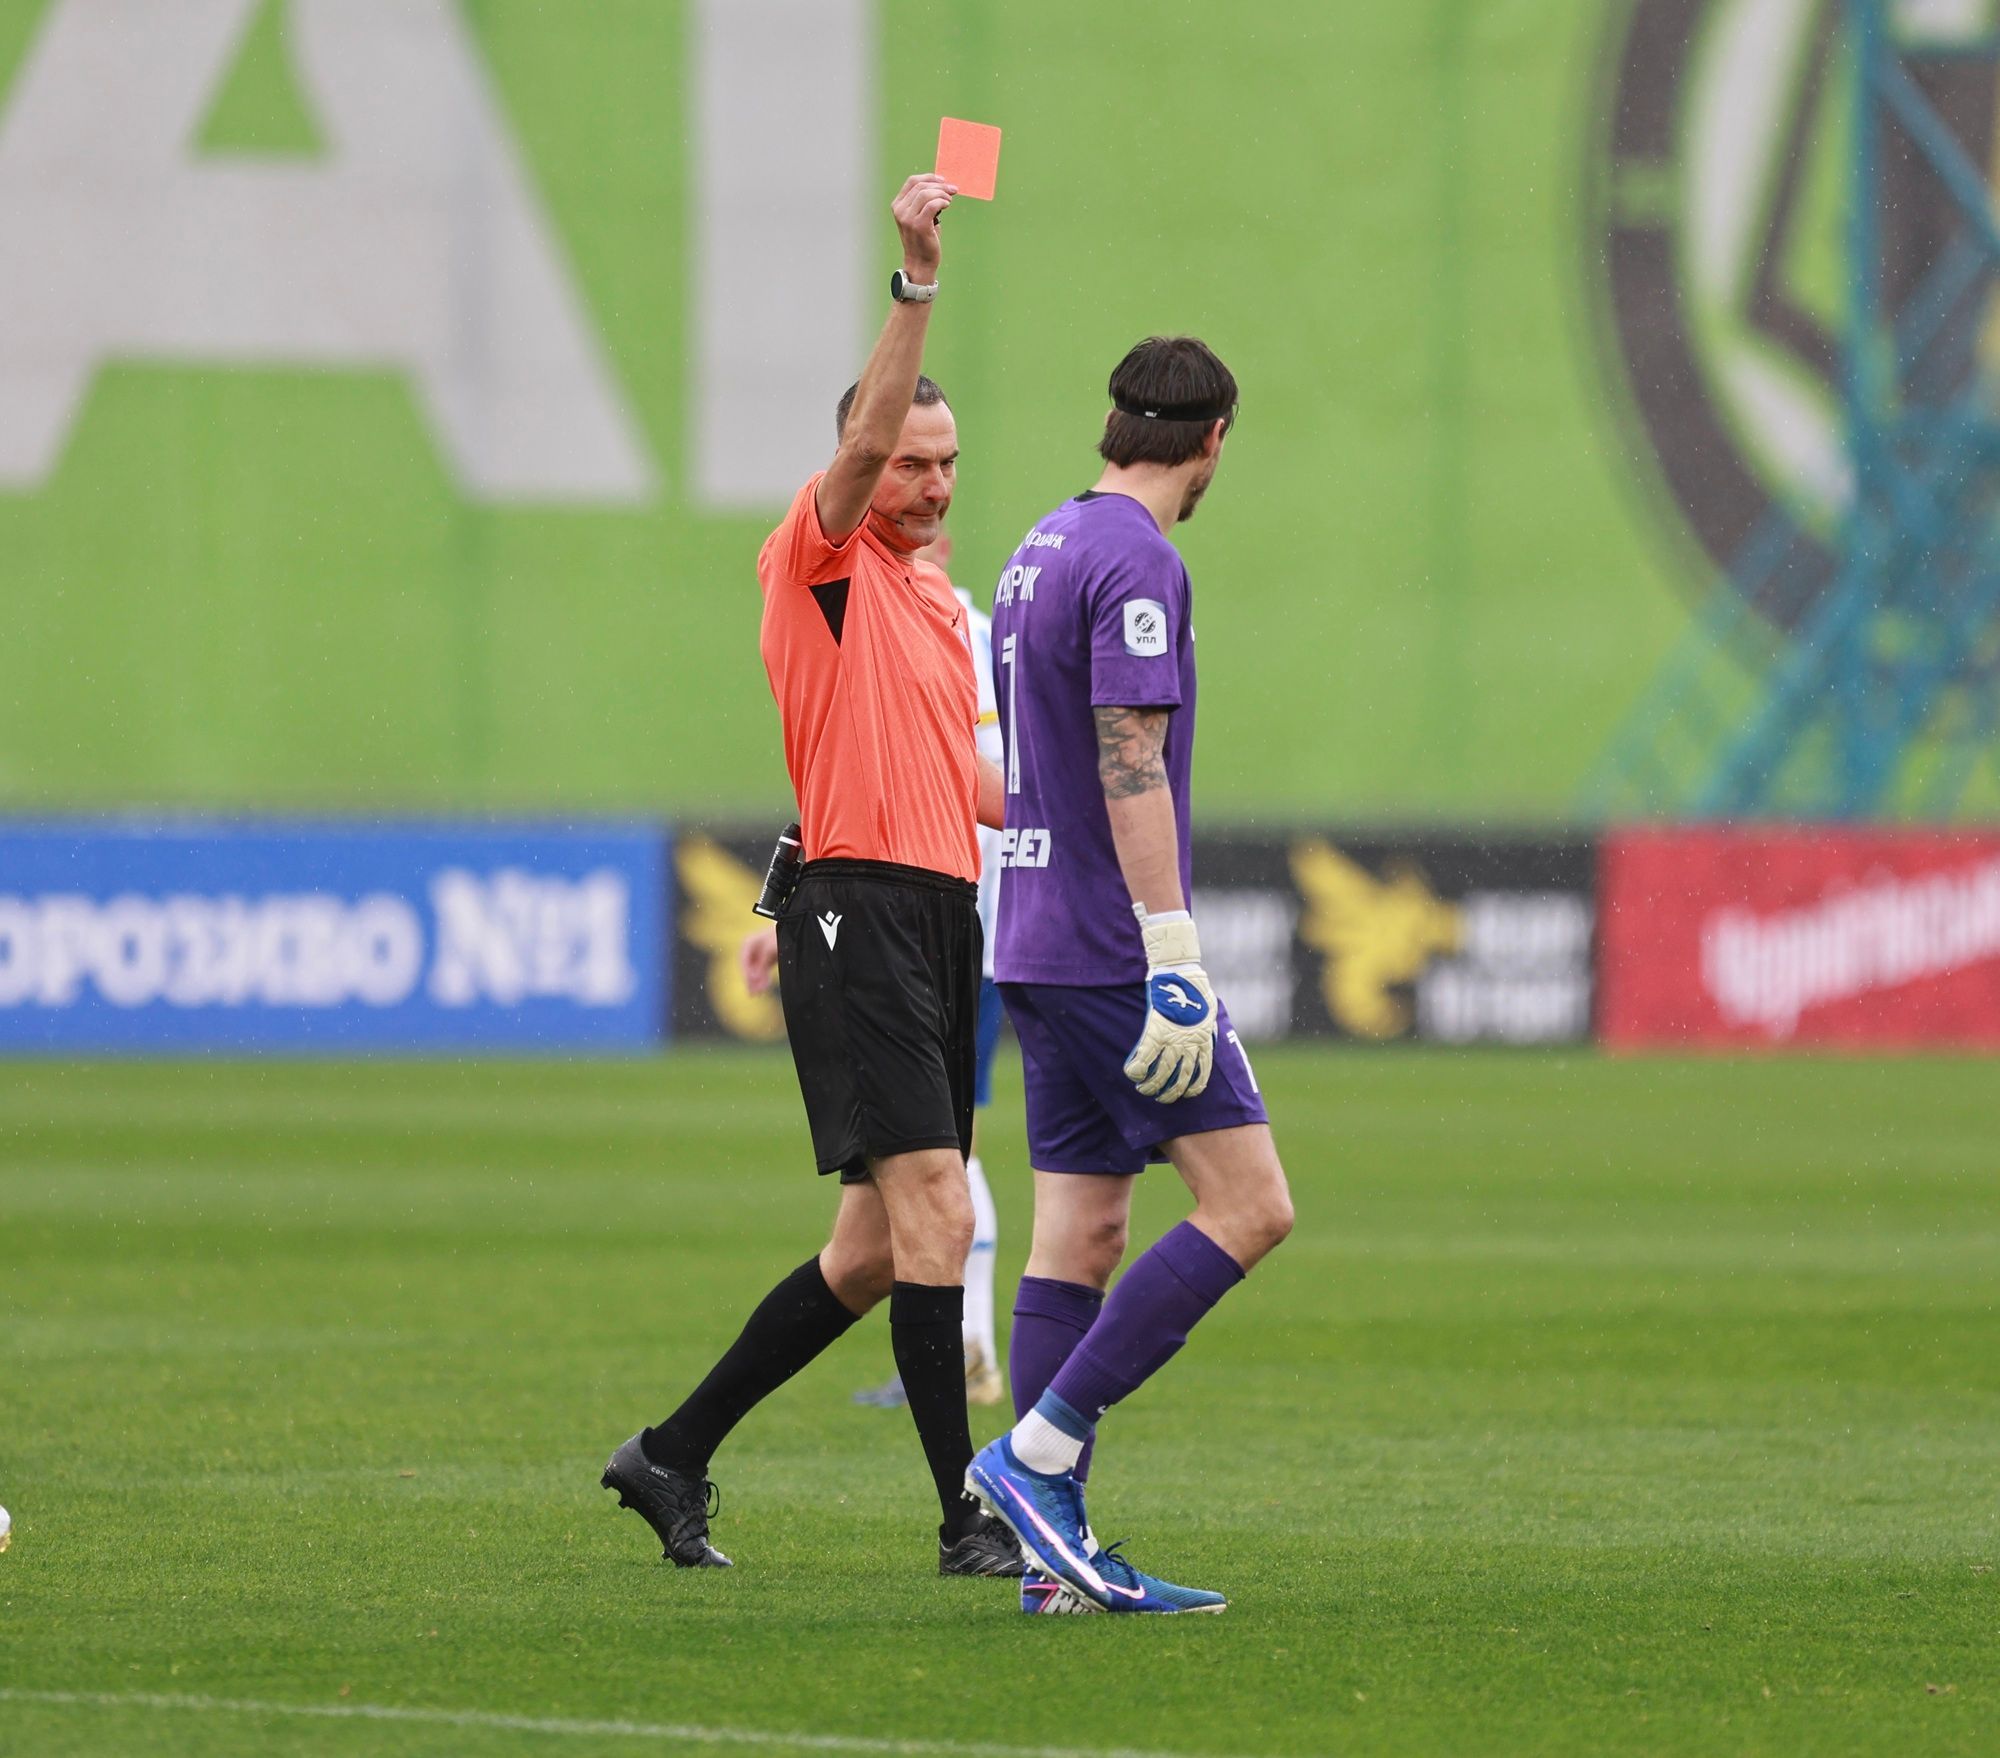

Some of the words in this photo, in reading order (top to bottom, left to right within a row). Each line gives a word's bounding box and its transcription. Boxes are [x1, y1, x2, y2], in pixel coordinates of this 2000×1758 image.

[1136, 636, 1157, 644] УПЛ
[1002, 633, 1021, 794] 1
[651, 1467, 668, 1479] COPA
